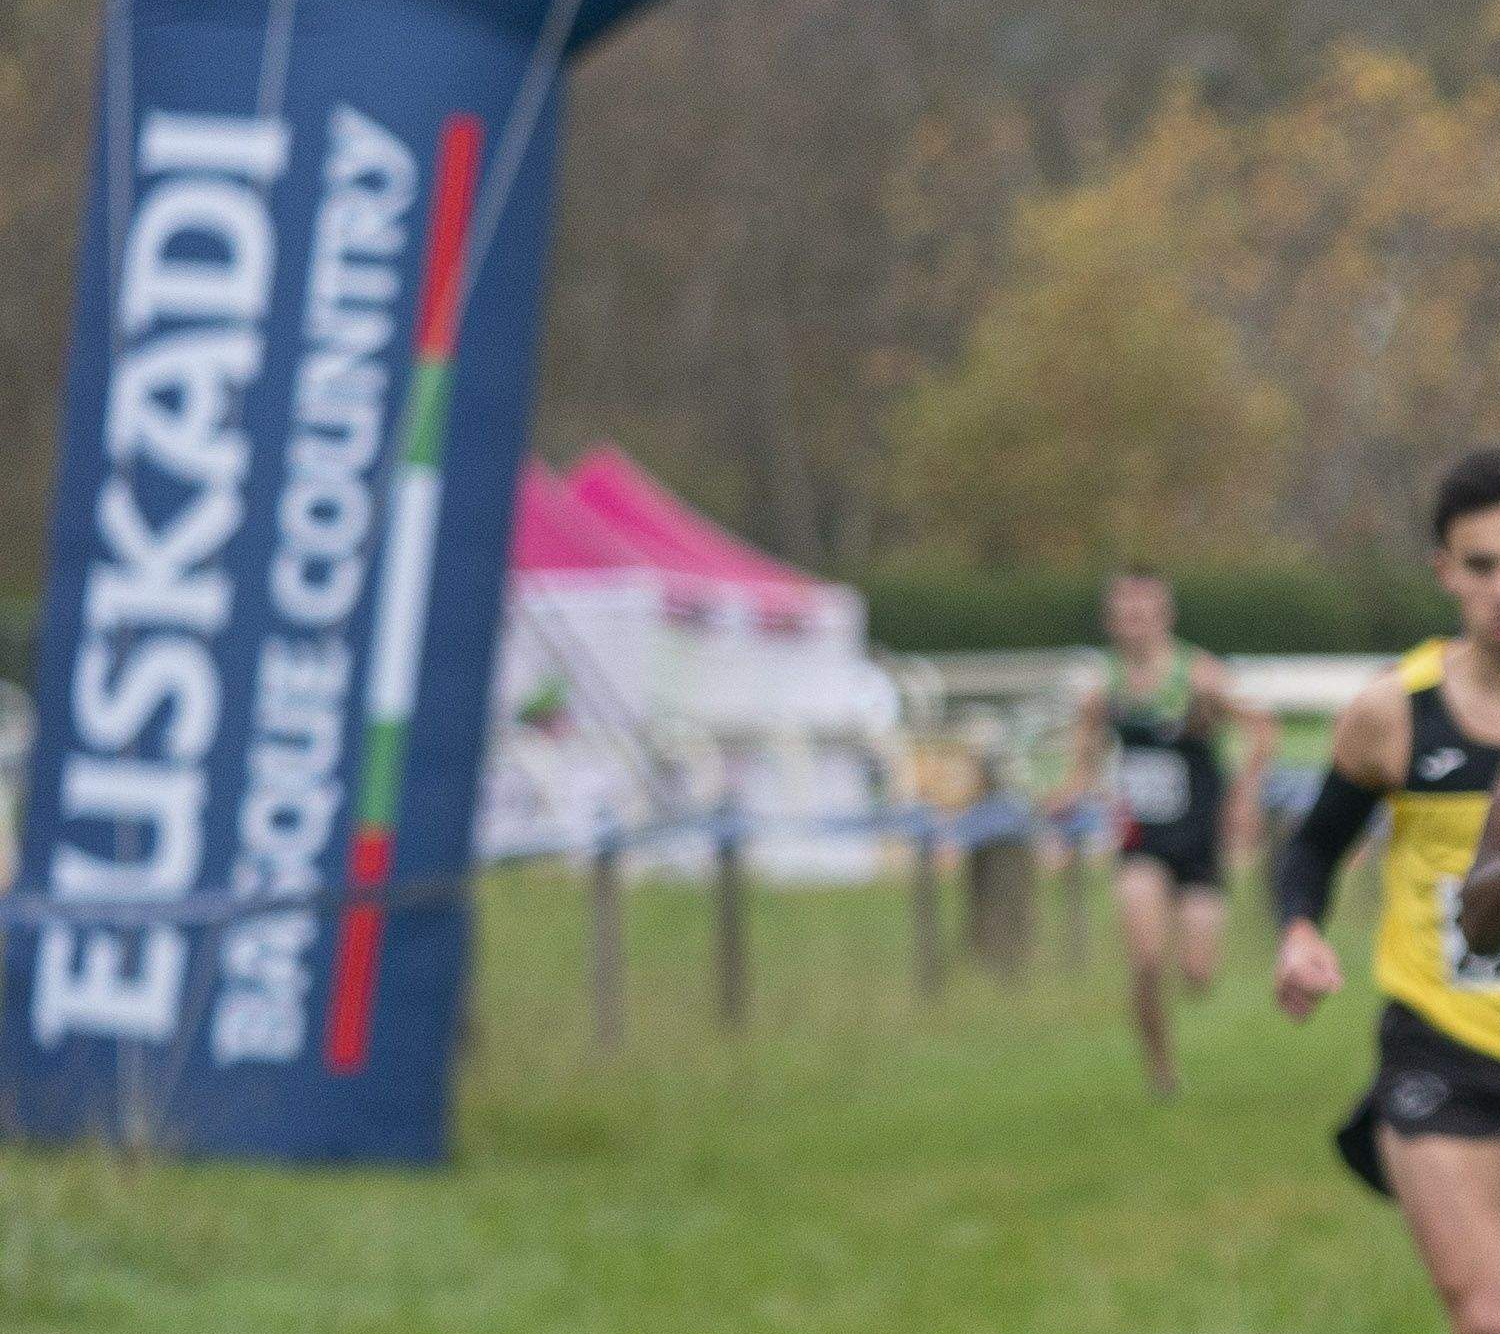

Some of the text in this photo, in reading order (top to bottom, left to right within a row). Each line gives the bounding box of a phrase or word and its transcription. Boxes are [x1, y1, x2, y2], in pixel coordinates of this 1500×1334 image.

[32, 110, 291, 1046] EUSKADI
[211, 104, 419, 1065] BASQUE COUNTRY
